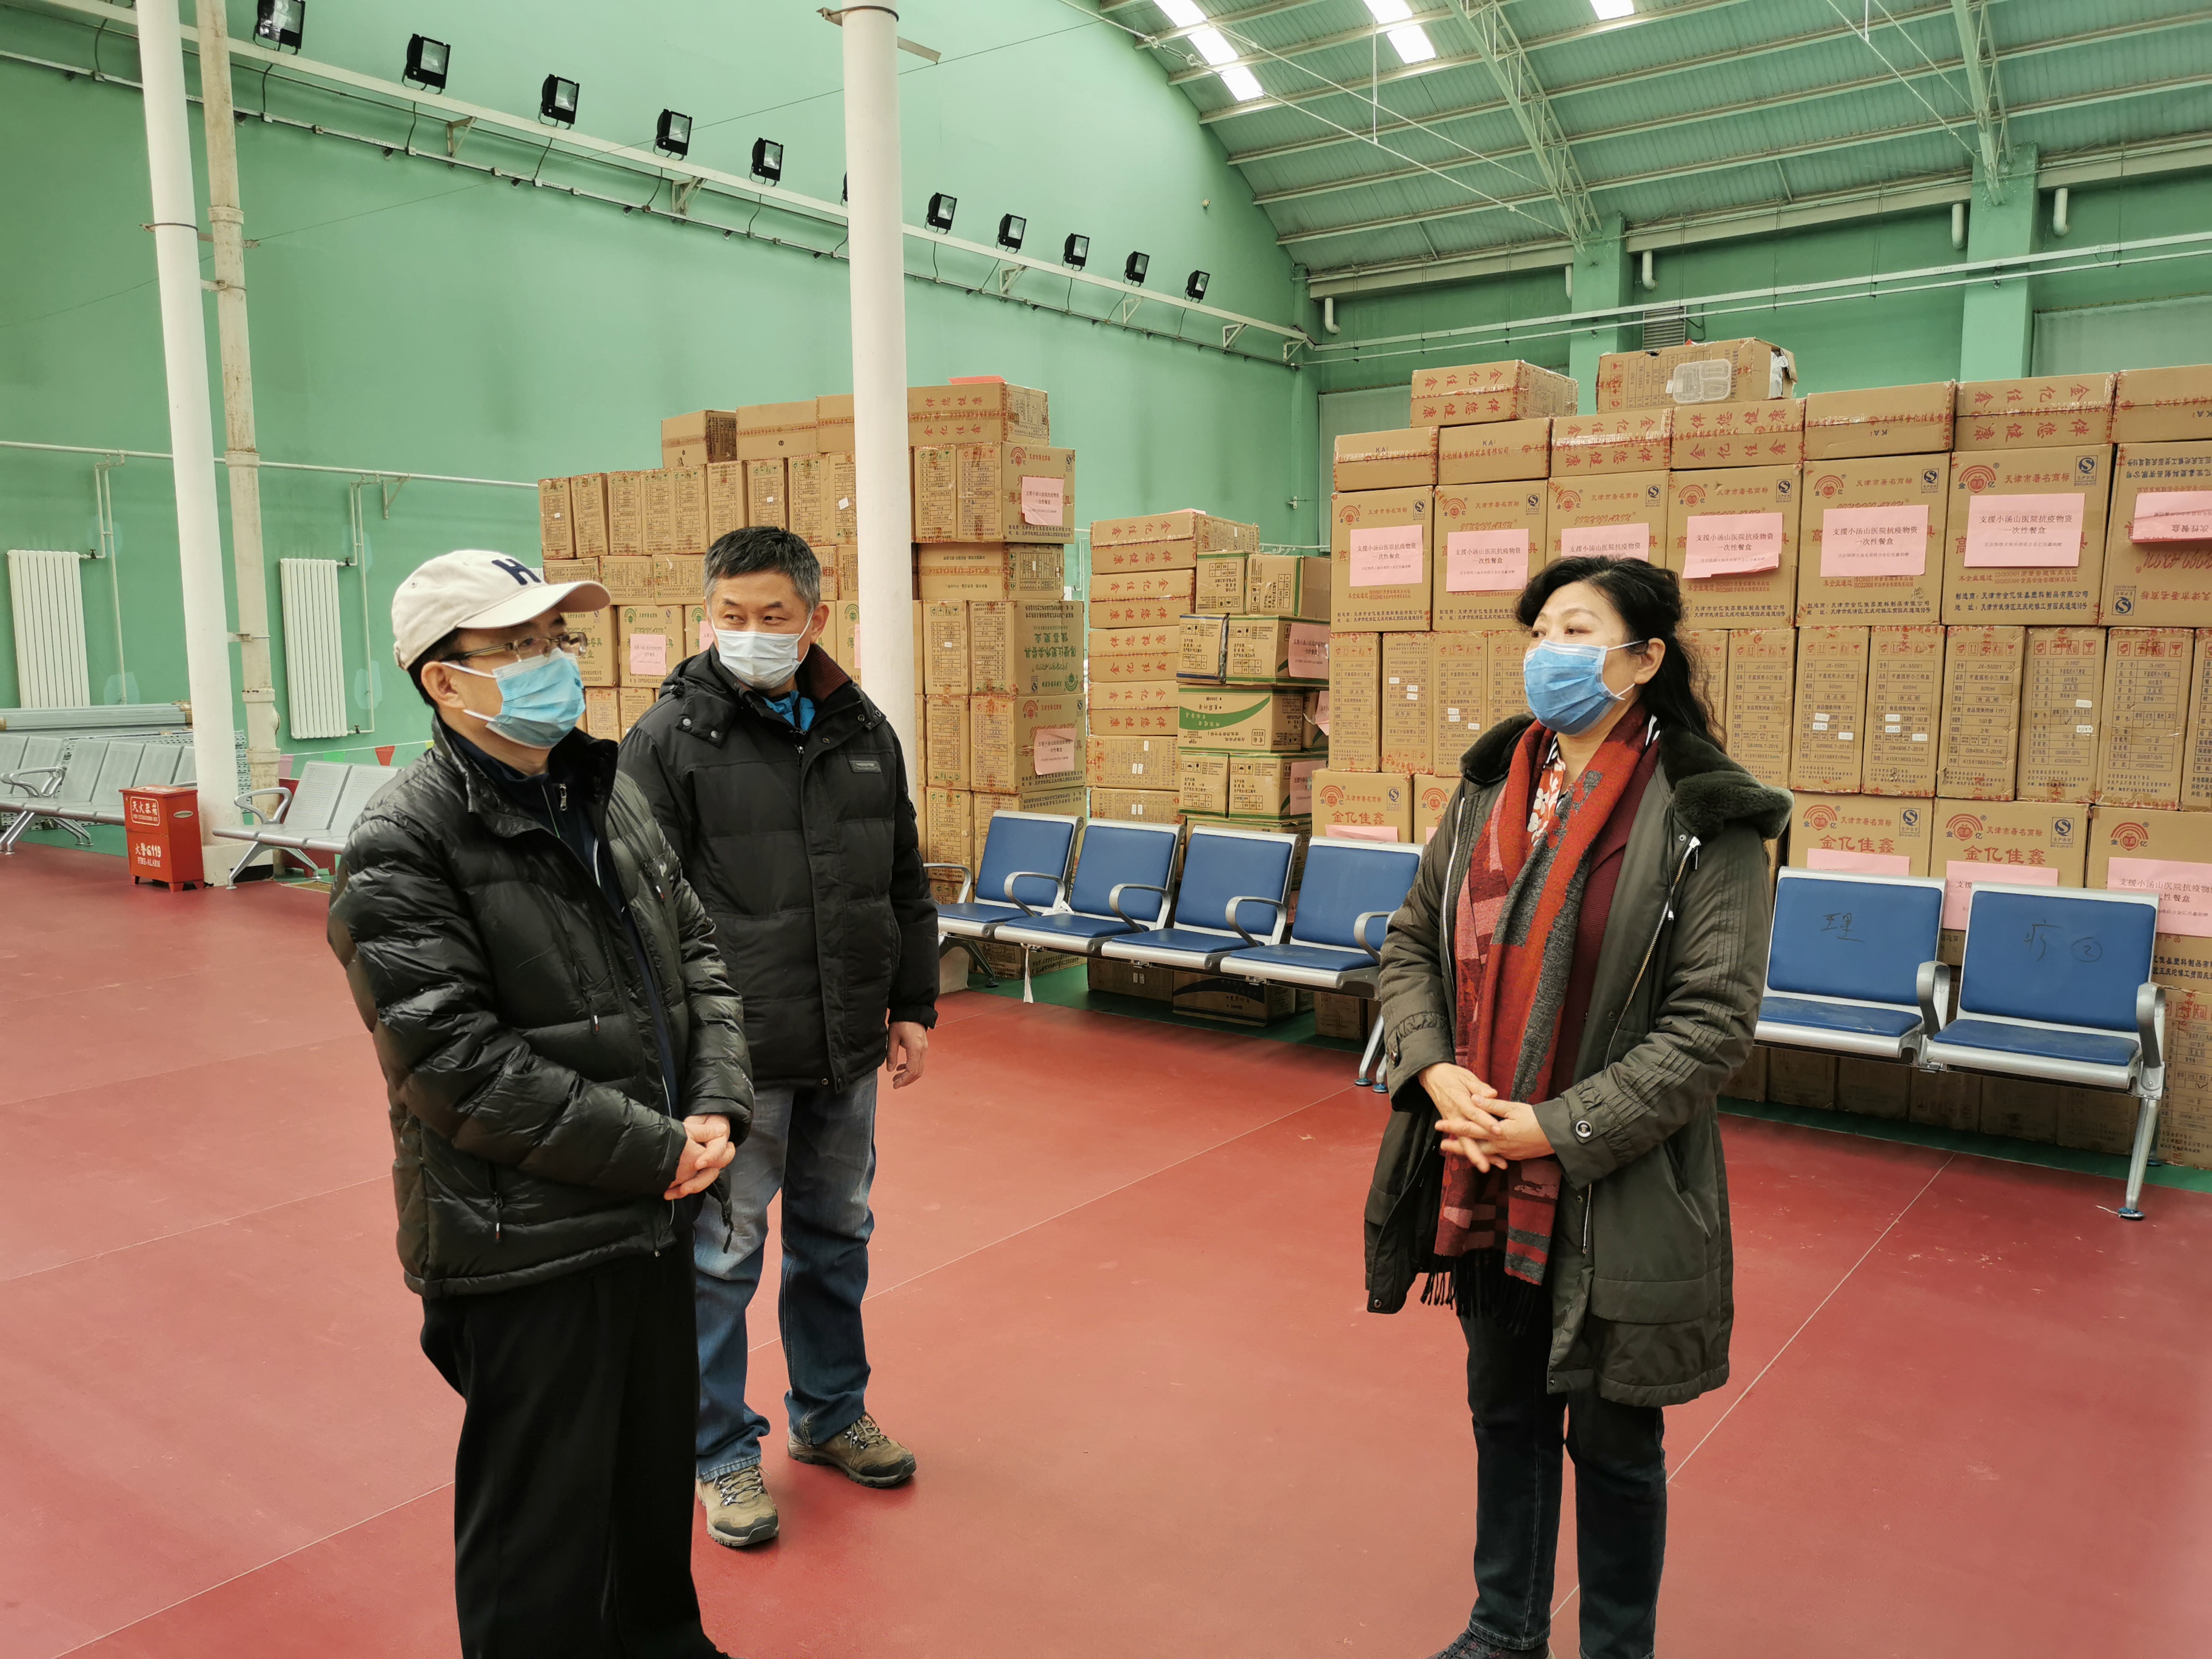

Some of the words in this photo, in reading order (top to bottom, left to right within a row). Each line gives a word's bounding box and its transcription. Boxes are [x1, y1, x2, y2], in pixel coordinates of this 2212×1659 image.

[1979, 515, 2072, 523] 支援小汤山医院抗疫物资
[1833, 526, 1918, 535] 支援小汤山医院抗疫物资
[1696, 533, 1774, 541] 支援小汤山医院抗疫物资
[1332, 810, 1384, 825] 金亿佳鑫
[1986, 826, 2043, 837] 天津市著名商标
[1820, 834, 1894, 854] 金亿佳鑫
[1963, 845, 2046, 865] 金亿佳鑫
